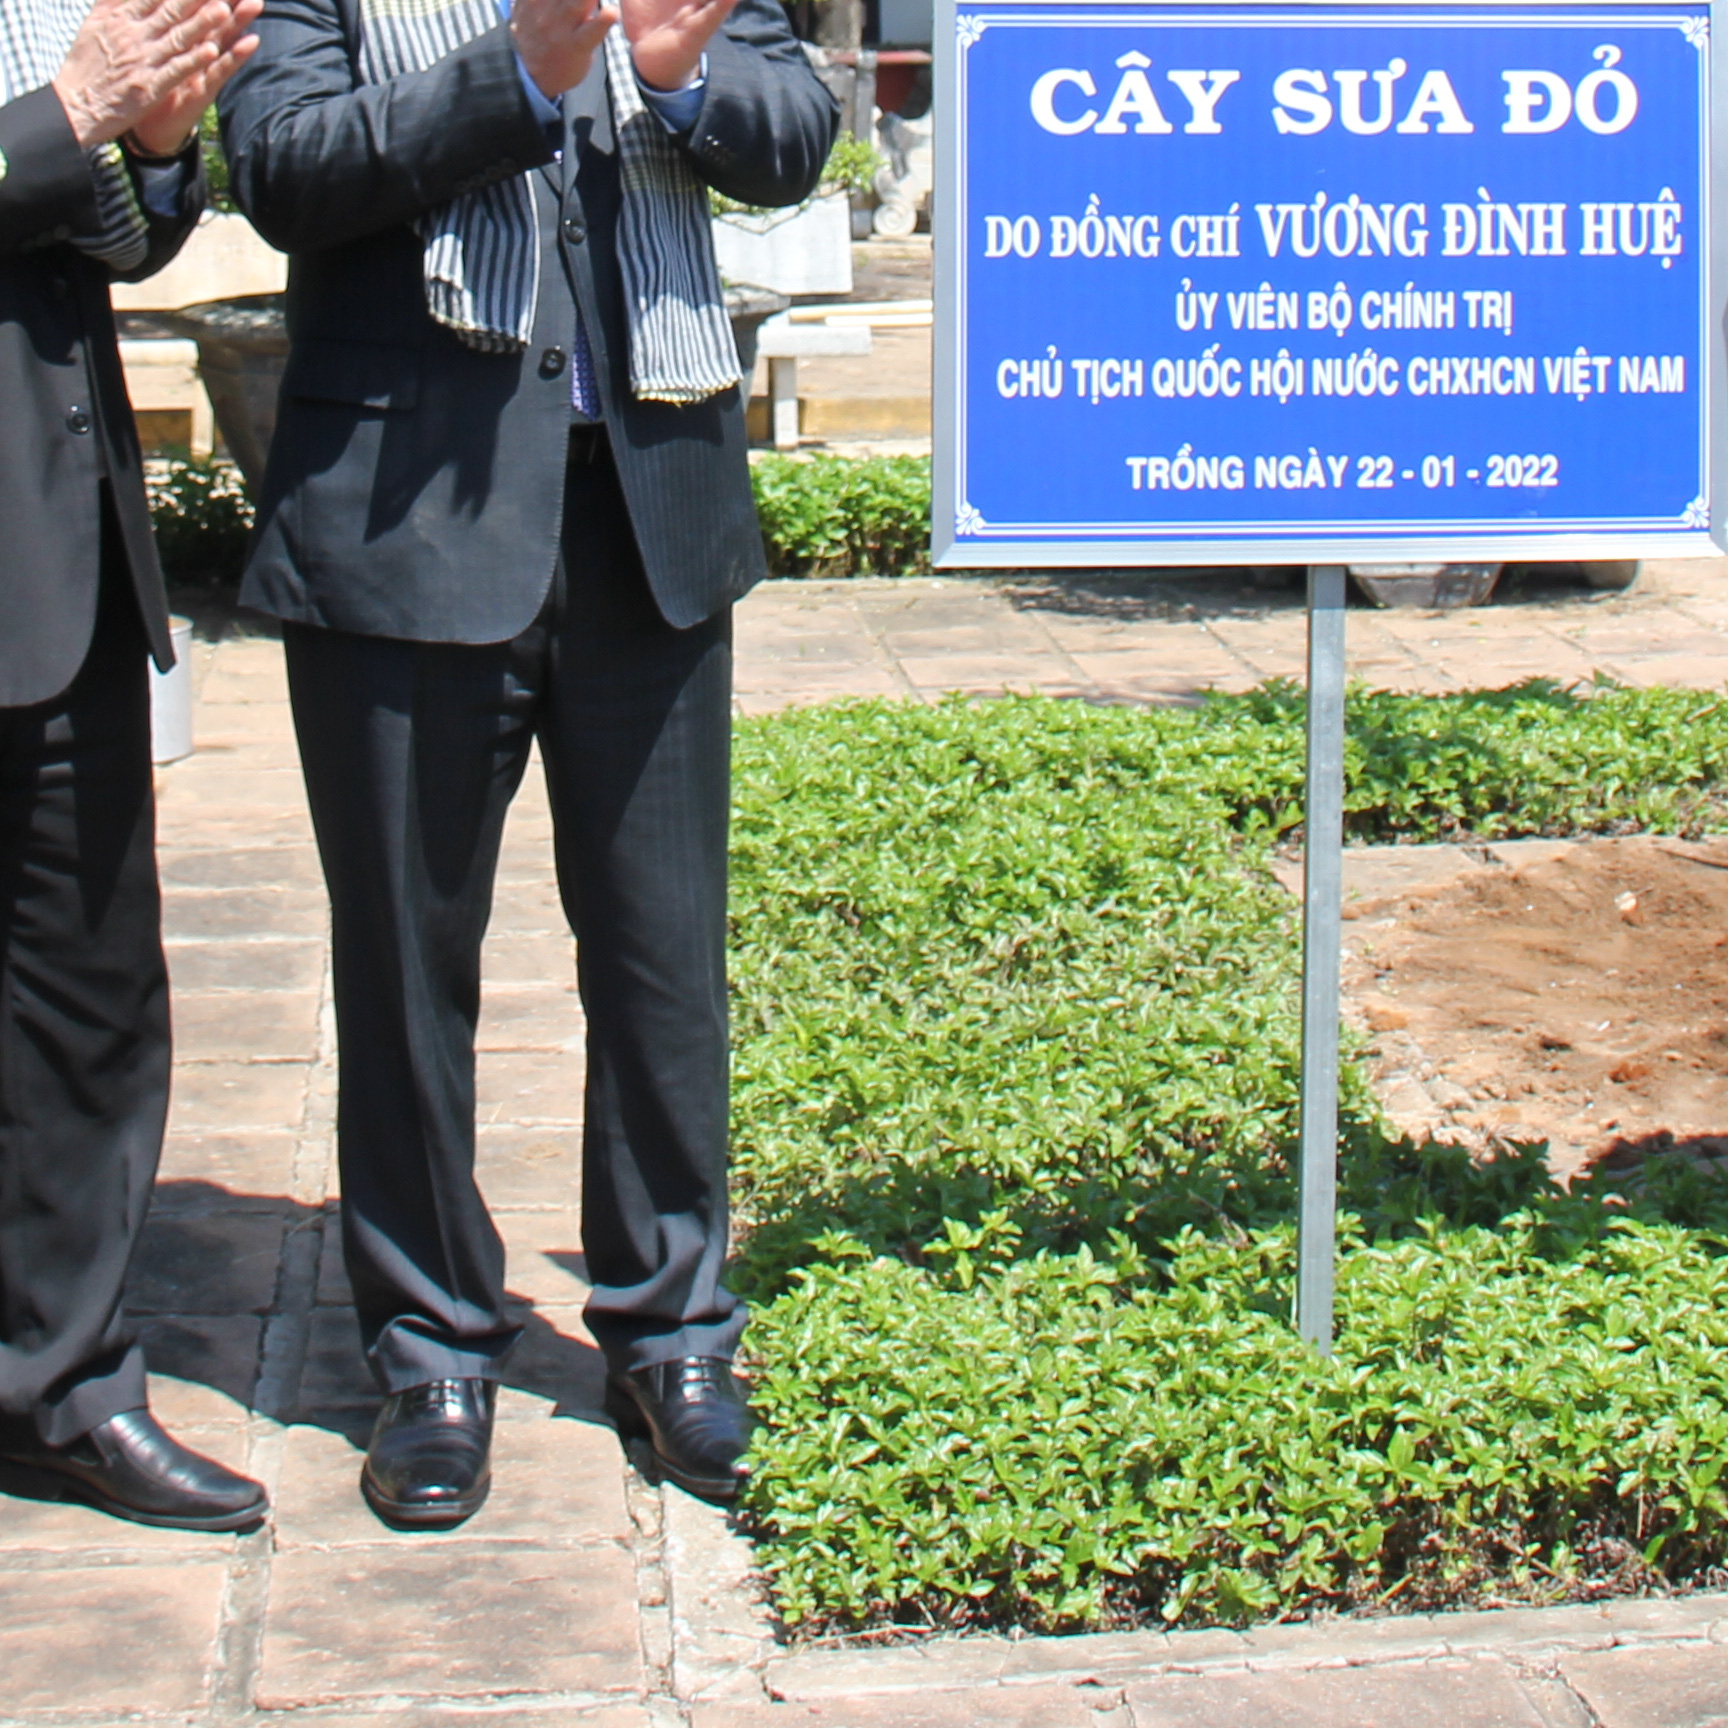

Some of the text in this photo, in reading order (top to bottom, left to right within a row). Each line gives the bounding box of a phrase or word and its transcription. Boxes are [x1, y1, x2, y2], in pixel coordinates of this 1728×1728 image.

[1029, 44, 1639, 136] CÂY SƯA ĐỎ
[984, 186, 1683, 270] DO ĐỒNG CHÍ VƯƠNG ĐÌNH HUỆ
[1175, 278, 1514, 338] ỦY VIÊN BỘ CHÍNH TRỊ
[996, 343, 1685, 405] CHỦ TỊCH QUỐC HỘI NƯỚC CHXHCN VIỆT NAM
[1126, 443, 1245, 491] TRỒNG
[1254, 447, 1350, 490] NGÀY
[1356, 456, 1394, 489] 22
[1421, 455, 1456, 489] 01
[1486, 454, 1560, 488] 2022
